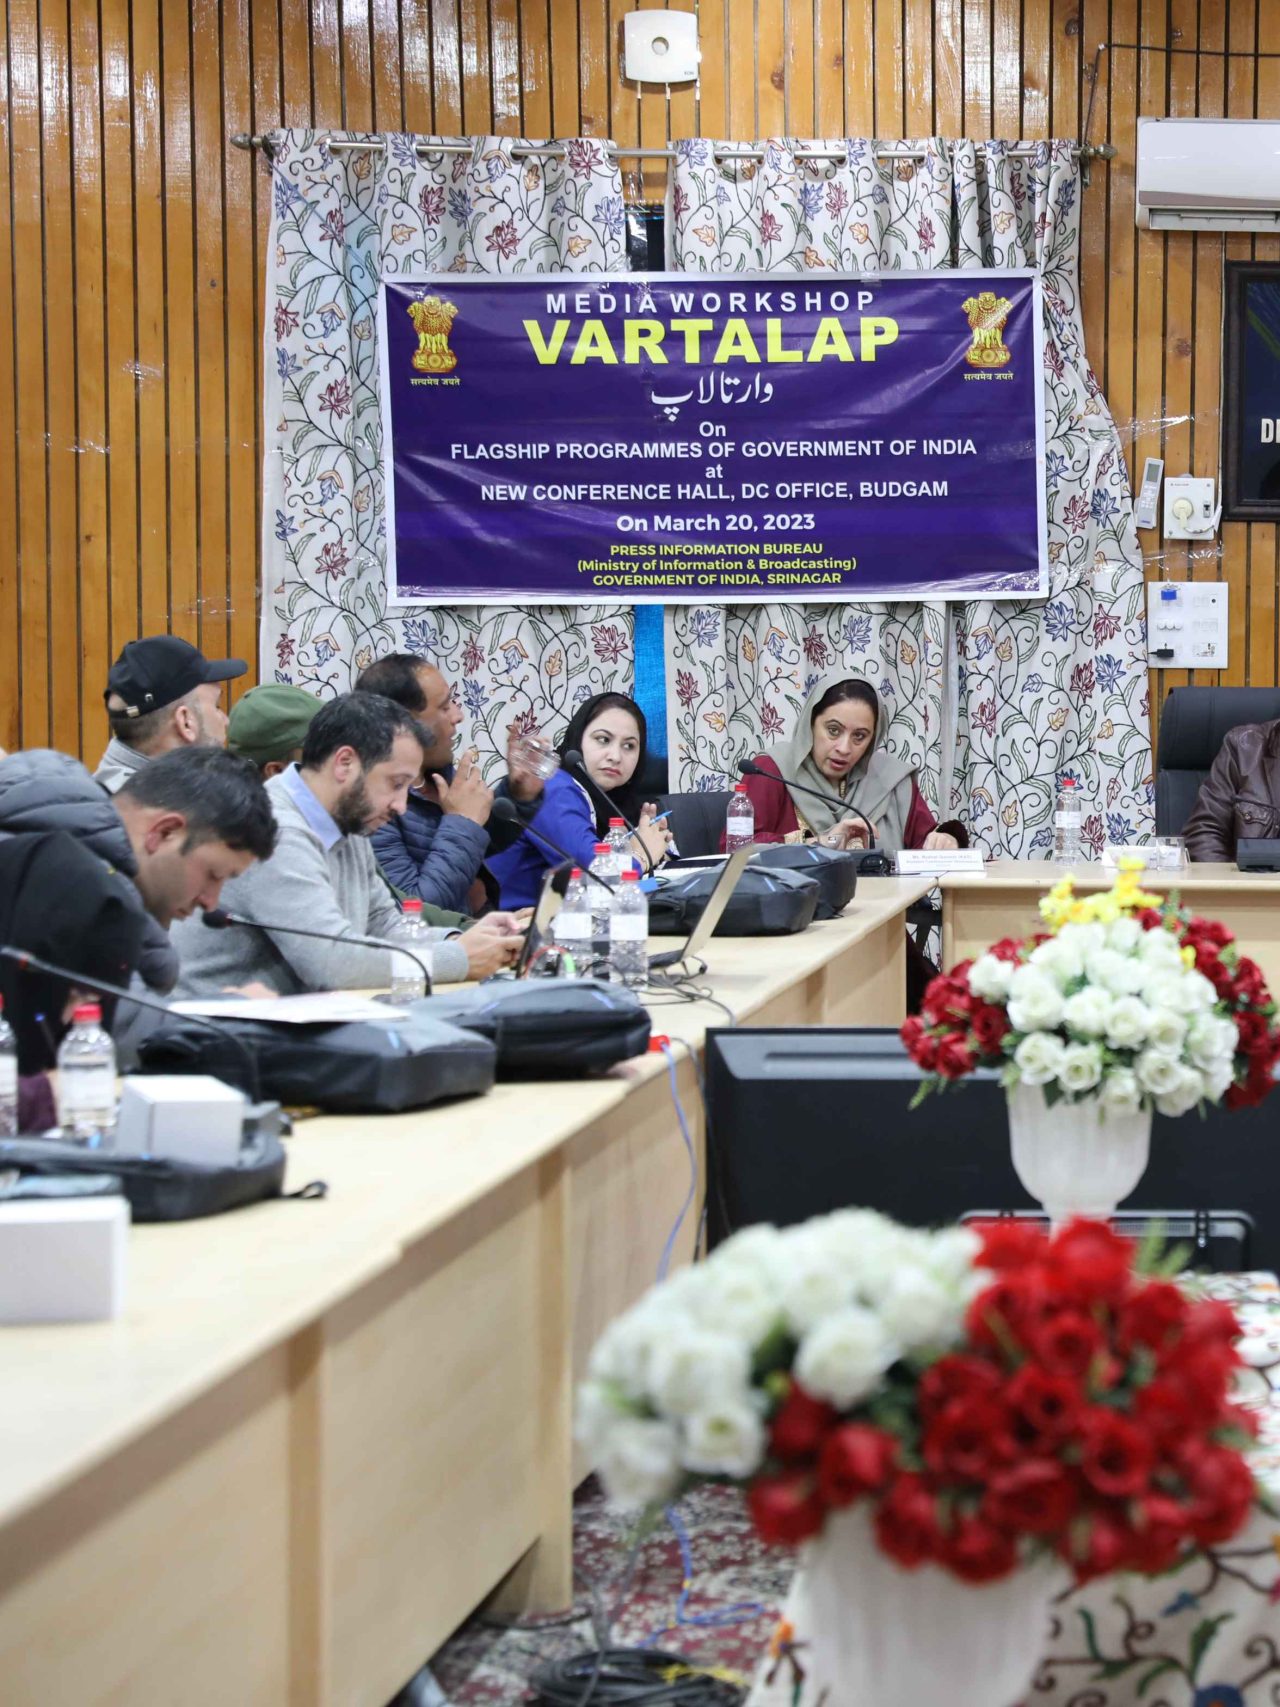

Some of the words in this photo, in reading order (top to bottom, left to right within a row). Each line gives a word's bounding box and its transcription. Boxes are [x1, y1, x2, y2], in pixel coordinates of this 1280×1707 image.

[547, 290, 657, 313] MEDIA
[668, 291, 873, 312] WORKSHOP
[523, 317, 899, 364] VARTALAP
[410, 376, 439, 386] सत्यमेव
[441, 376, 460, 386] जयते
[963, 370, 992, 381] सत्यमेव
[994, 370, 1014, 381] जयते
[652, 371, 773, 421] وارتالاپ
[700, 422, 726, 437] On
[451, 444, 549, 459] FLAGSHIP
[557, 442, 702, 458] PROGRAMMES
[709, 442, 735, 457] OF
[742, 441, 883, 457] GOVERNMENT
[890, 440, 916, 455] OF
[923, 439, 976, 454] INDIA
[706, 464, 723, 478] at
[482, 485, 527, 500] NEW
[533, 484, 671, 500] CONFERENCE
[678, 484, 737, 503] HALL,
[742, 483, 769, 498] DC
[776, 482, 853, 502] OFFICE,
[860, 481, 947, 497] BUDGAM
[616, 516, 647, 531] On
[654, 514, 720, 531] March
[725, 514, 758, 534] 20,
[763, 514, 815, 530] 2023
[611, 545, 656, 555] PRESS
[660, 544, 759, 555] INFORMATION
[764, 544, 822, 554] BUREAU
[578, 559, 639, 573] (Ministry
[644, 560, 657, 570] of
[660, 559, 742, 570] Information
[747, 559, 755, 569] &
[759, 557, 857, 572] Broadcasting)
[593, 575, 694, 586] GOVERNMENT
[698, 575, 718, 585] OF
[721, 574, 764, 587] INDIA,
[768, 573, 841, 584] SRINAGAR
